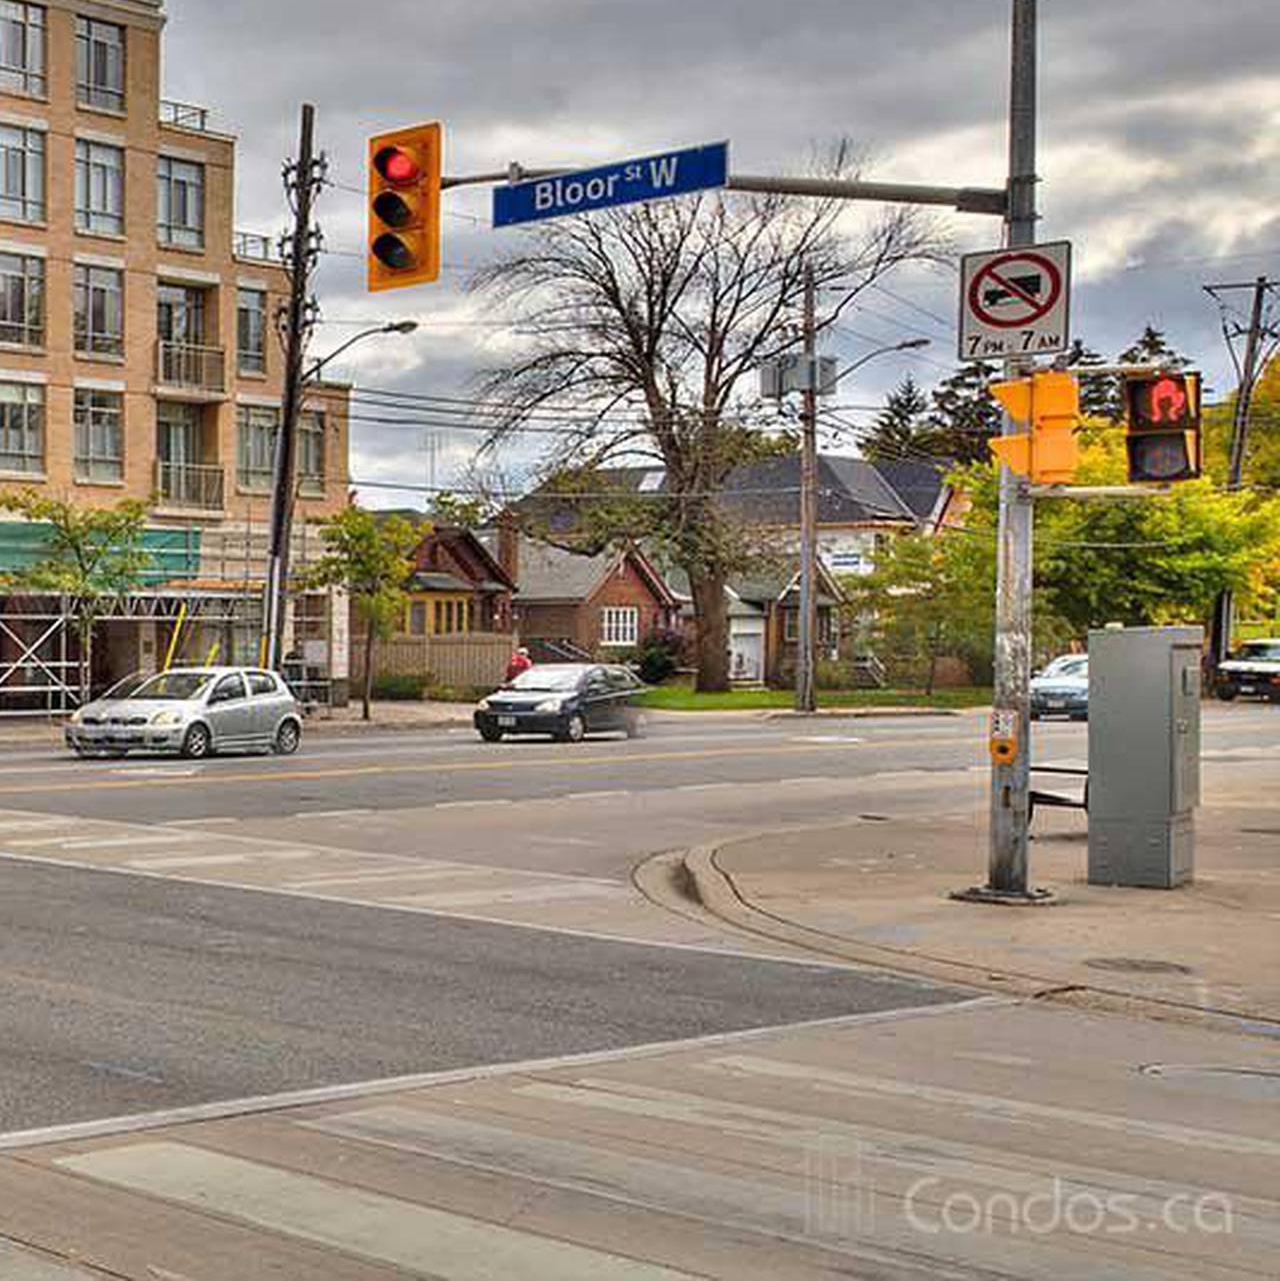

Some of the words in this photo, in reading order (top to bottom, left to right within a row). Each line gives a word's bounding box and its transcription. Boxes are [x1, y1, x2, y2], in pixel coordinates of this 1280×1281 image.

[534, 174, 621, 211] Bloor
[624, 166, 641, 181] St
[650, 157, 678, 189] W
[967, 335, 981, 355] 7
[1021, 330, 1034, 350] 7
